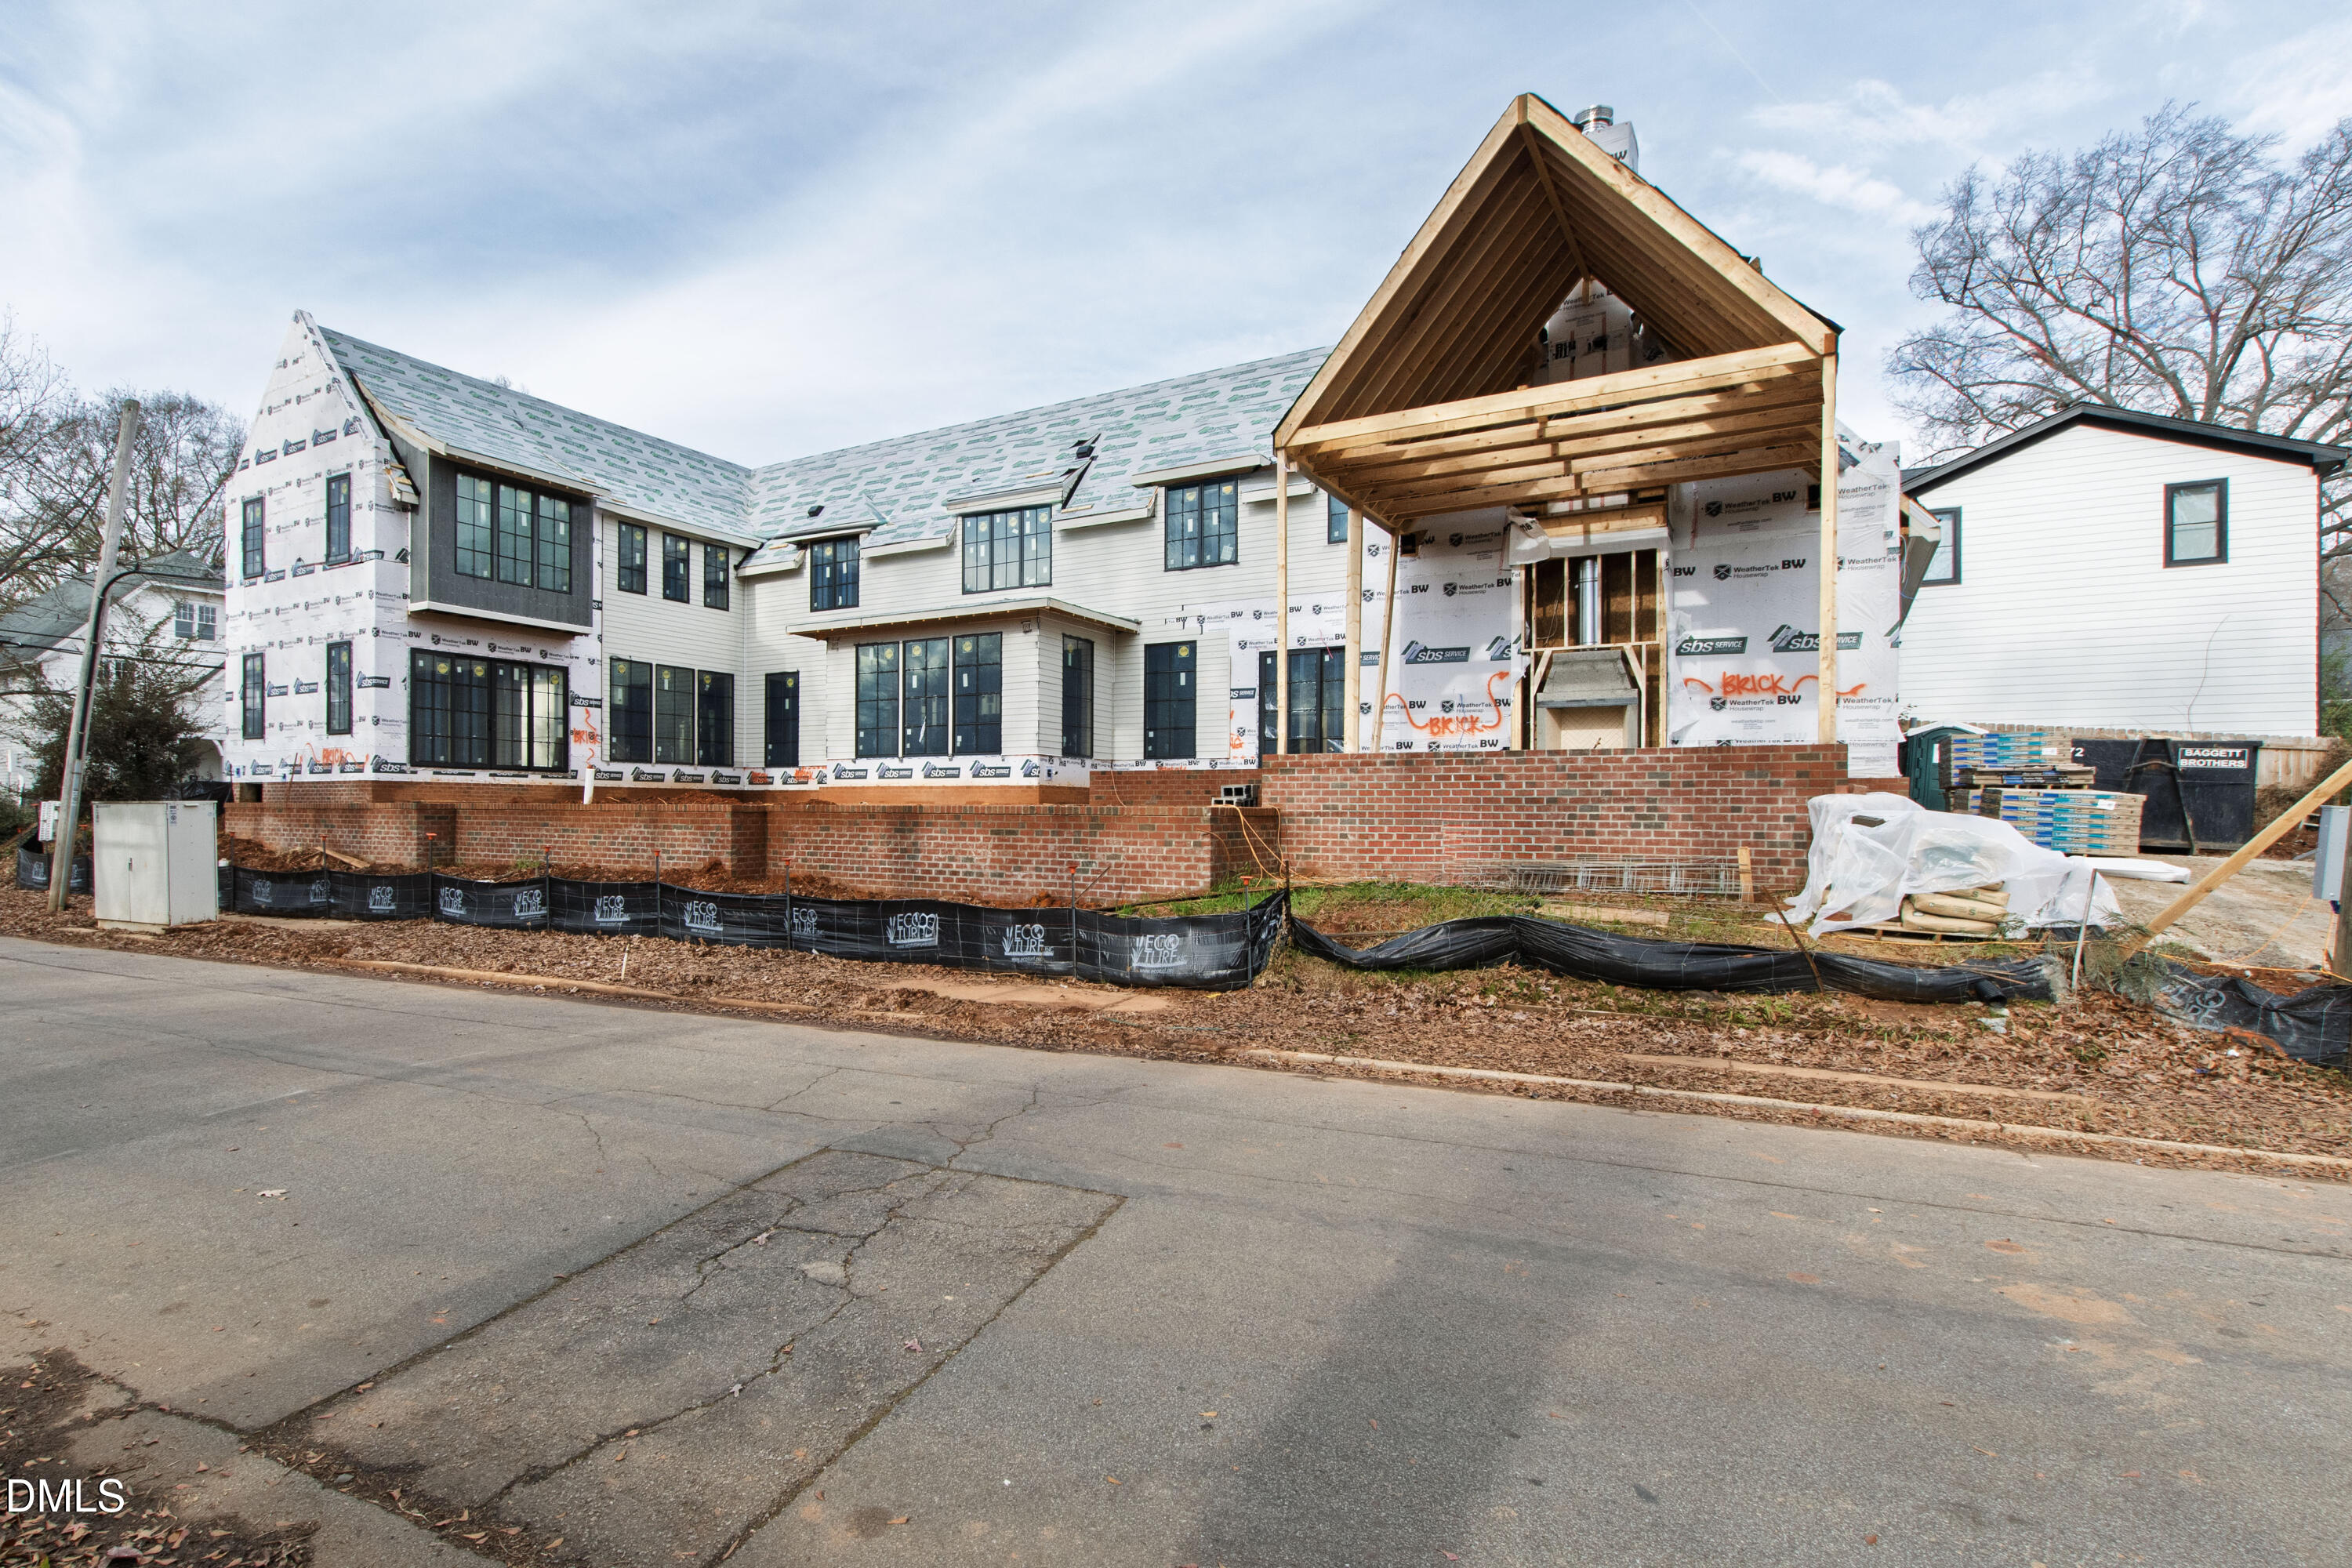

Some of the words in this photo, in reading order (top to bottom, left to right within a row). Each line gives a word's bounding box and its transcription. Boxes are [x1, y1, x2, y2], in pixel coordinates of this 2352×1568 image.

[1838, 484, 1887, 494] WeatherTek
[1725, 499, 1770, 509] WeatherTek
[1773, 491, 1796, 503] BW
[1673, 566, 1696, 577] BW
[1733, 564, 1779, 573] WeatherTek
[1782, 558, 1806, 570] BW
[1411, 584, 1429, 593] BW
[1836, 635, 1858, 644] RVICE
[1680, 641, 1714, 653] sbs
[1417, 650, 1443, 662] sbs
[361, 677, 372, 687] sbs
[1722, 671, 1790, 696] BRICK
[1409, 700, 1426, 709] BW
[1777, 695, 1801, 705] BW
[1429, 715, 1484, 736] BRICK
[1396, 741, 1413, 750] BW
[1480, 739, 1498, 748] BW
[2184, 749, 2242, 757] BAGGETT
[379, 763, 401, 772] sbs
[2180, 758, 2245, 768] BROTHERS
[884, 768, 899, 778] sbs
[931, 768, 946, 777] sbs
[979, 767, 995, 776] sbs
[376, 886, 394, 898] ECO
[445, 887, 463, 901] ECO
[522, 889, 542, 902] ECO
[376, 895, 392, 907] TURF
[445, 898, 463, 910] TURF
[521, 901, 541, 913] TURF
[603, 895, 625, 908] ECO
[603, 907, 624, 919] TURF
[693, 901, 717, 916] ECO
[693, 914, 717, 927] TURF
[793, 907, 818, 924] ECO
[793, 921, 818, 934] TURF
[1014, 924, 1044, 941] ECO
[1014, 938, 1044, 953] TURF
[1145, 934, 1179, 951] ECO
[1144, 949, 1178, 964] TURF
